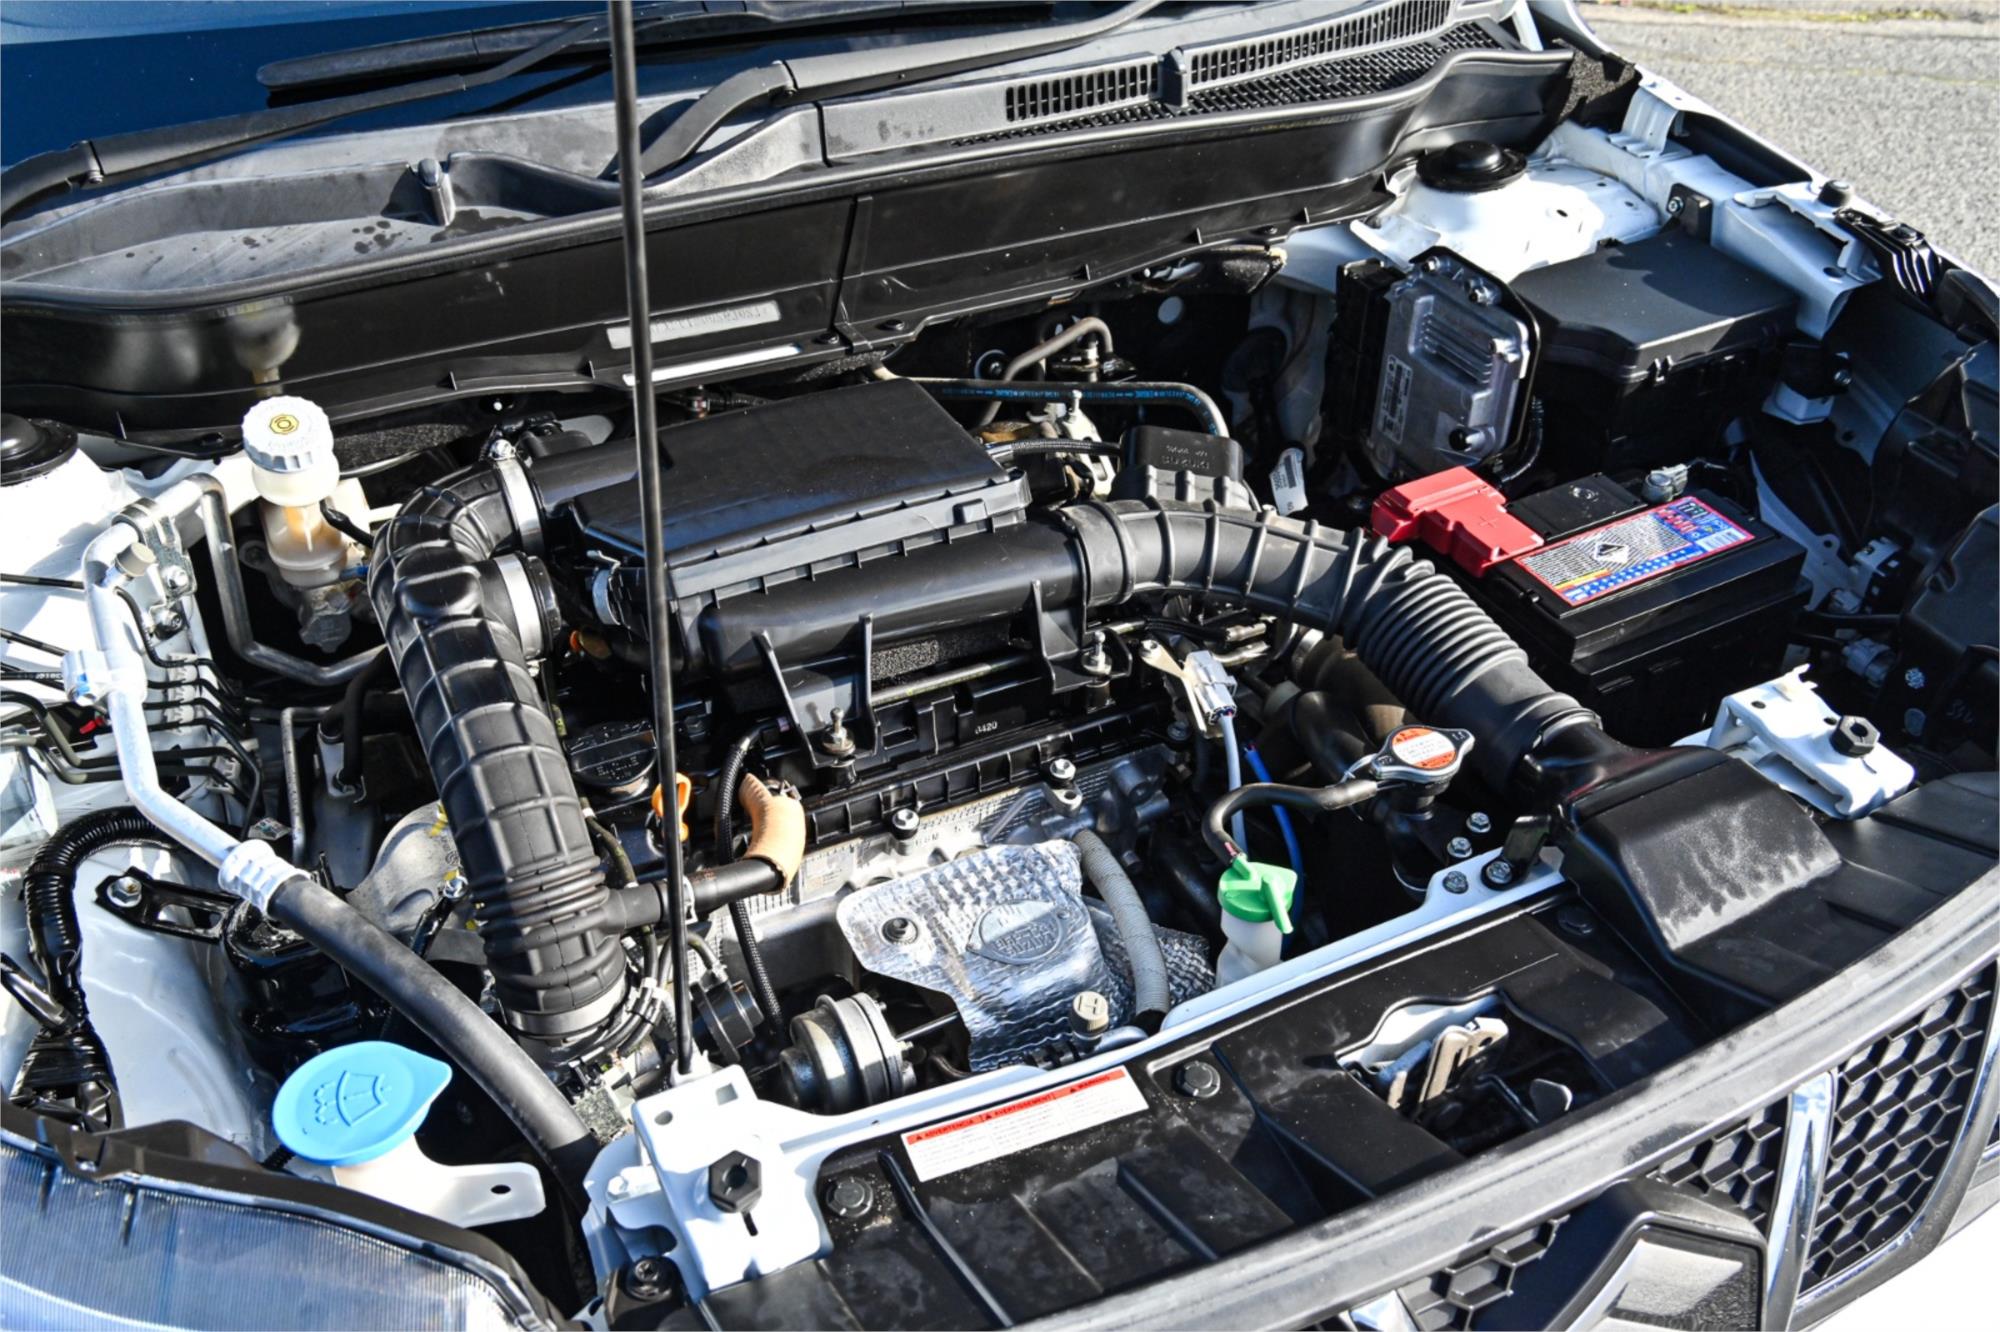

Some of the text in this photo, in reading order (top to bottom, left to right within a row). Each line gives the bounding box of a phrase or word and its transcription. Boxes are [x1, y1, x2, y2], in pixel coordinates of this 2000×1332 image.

[1077, 995, 1098, 1015] H
[1078, 1075, 1110, 1090] WARNING
[924, 1119, 975, 1138] ADVERTENCIA
